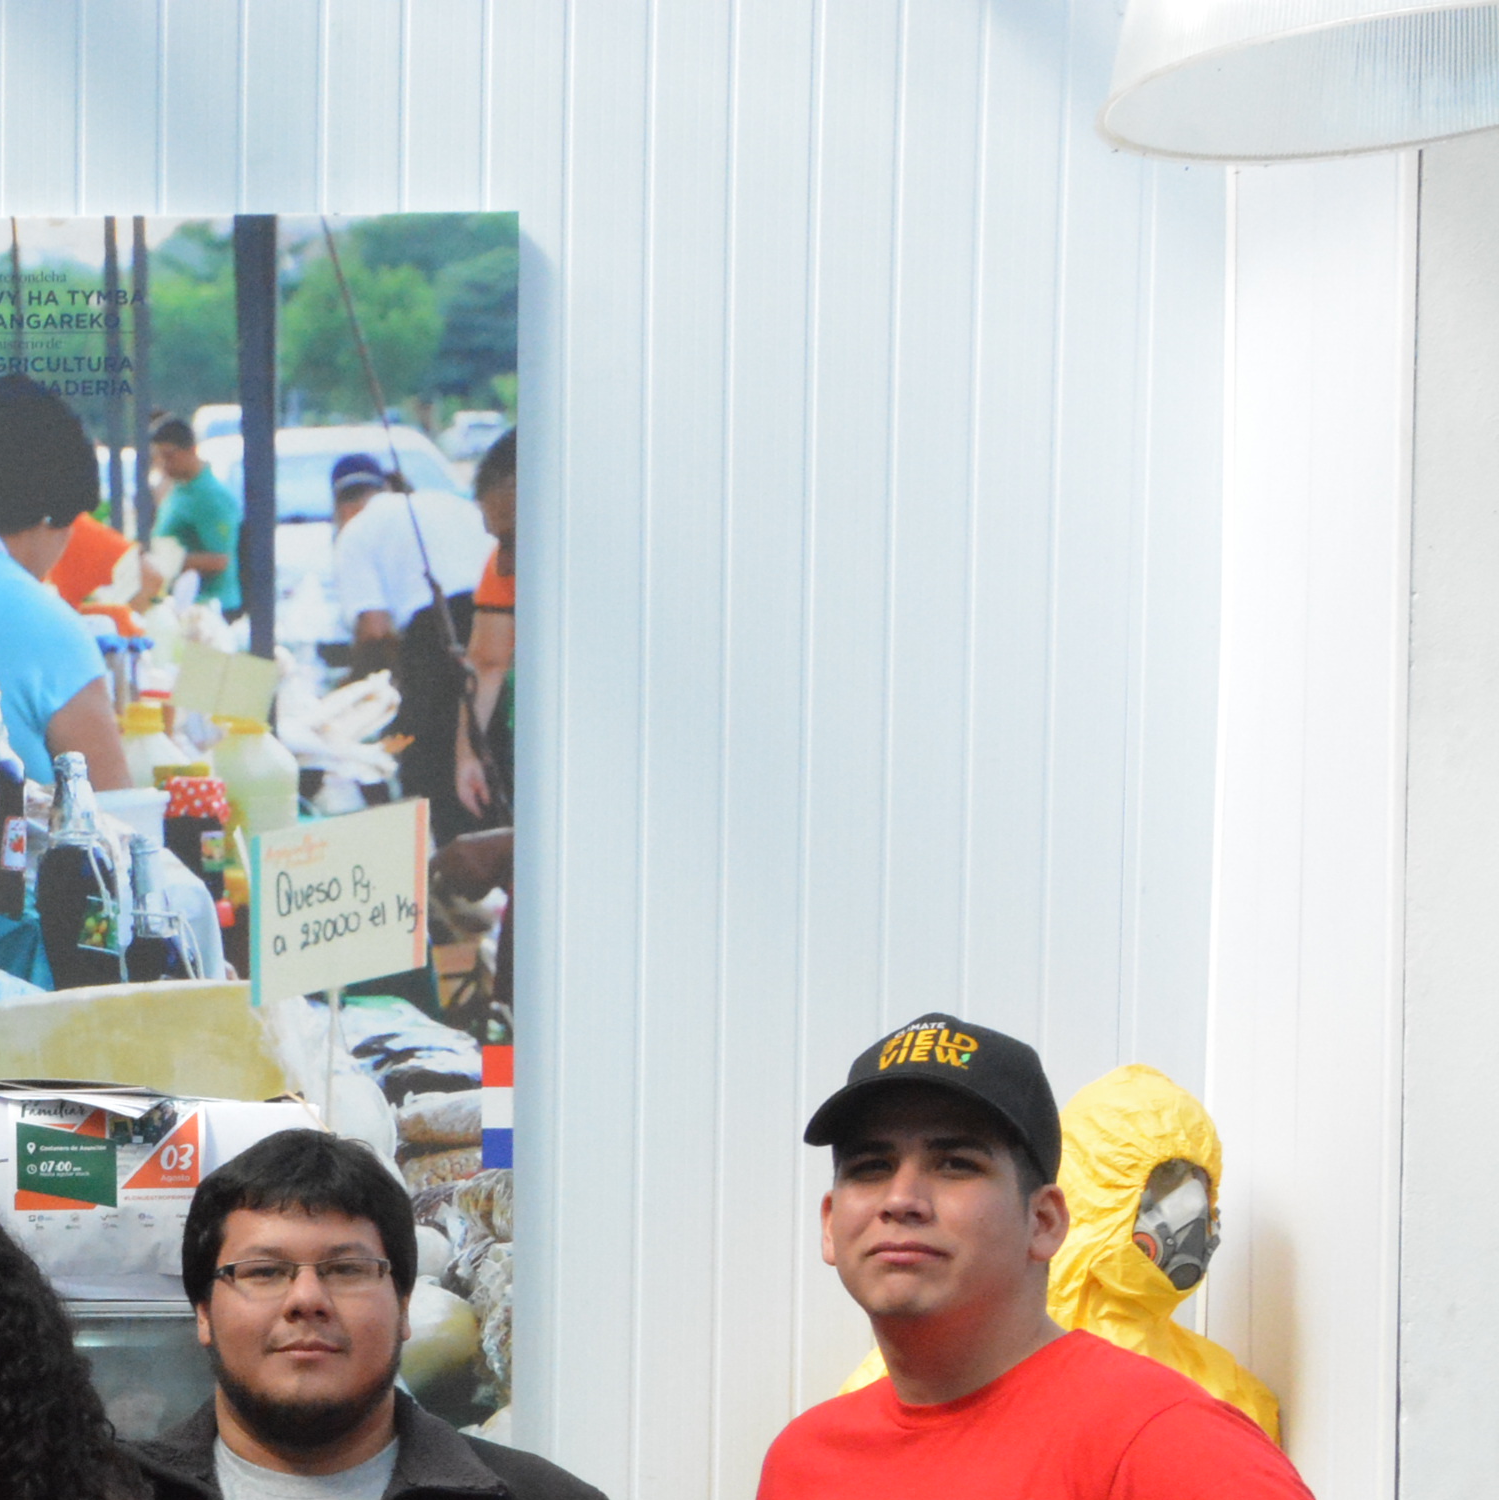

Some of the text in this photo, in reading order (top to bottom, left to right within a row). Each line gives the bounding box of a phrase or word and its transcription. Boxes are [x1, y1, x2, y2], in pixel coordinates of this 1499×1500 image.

[27, 290, 59, 306] HA
[66, 290, 145, 306] TYMBA
[46, 337, 63, 350] de
[276, 870, 342, 917] Queso
[273, 935, 287, 956] a
[368, 901, 387, 927] el
[882, 1028, 980, 1054] FIELD
[878, 1045, 964, 1071] VIEW
[39, 1160, 72, 1173] 07:00
[159, 1143, 194, 1171] 03
[160, 1174, 191, 1183] Agosto
